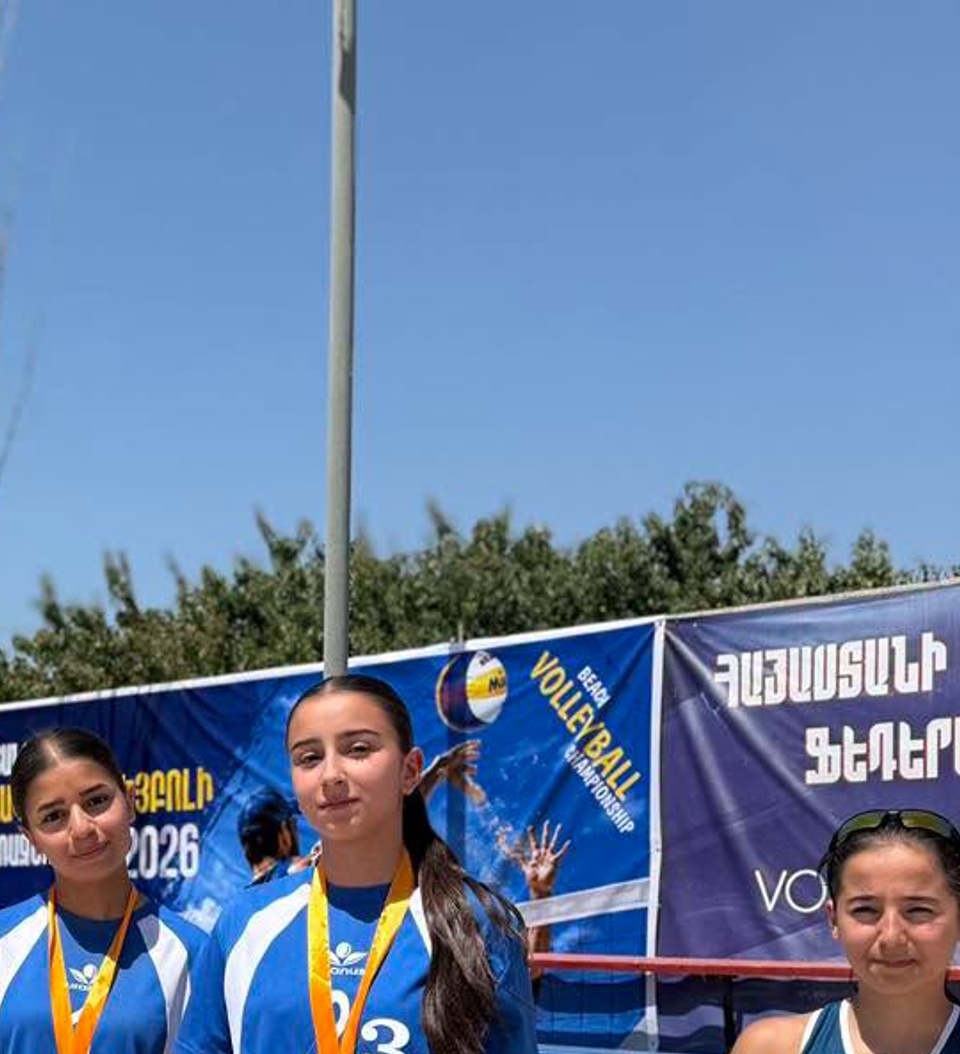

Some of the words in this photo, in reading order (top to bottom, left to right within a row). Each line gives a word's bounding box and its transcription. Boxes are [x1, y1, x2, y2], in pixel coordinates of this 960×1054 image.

[713, 632, 948, 709] ՀԱՅԱՍՏԱՆԻ
[530, 651, 641, 801] VOLLEYBALL
[563, 744, 635, 834] CHAMPIONSHIP
[125, 823, 199, 879] 2026
